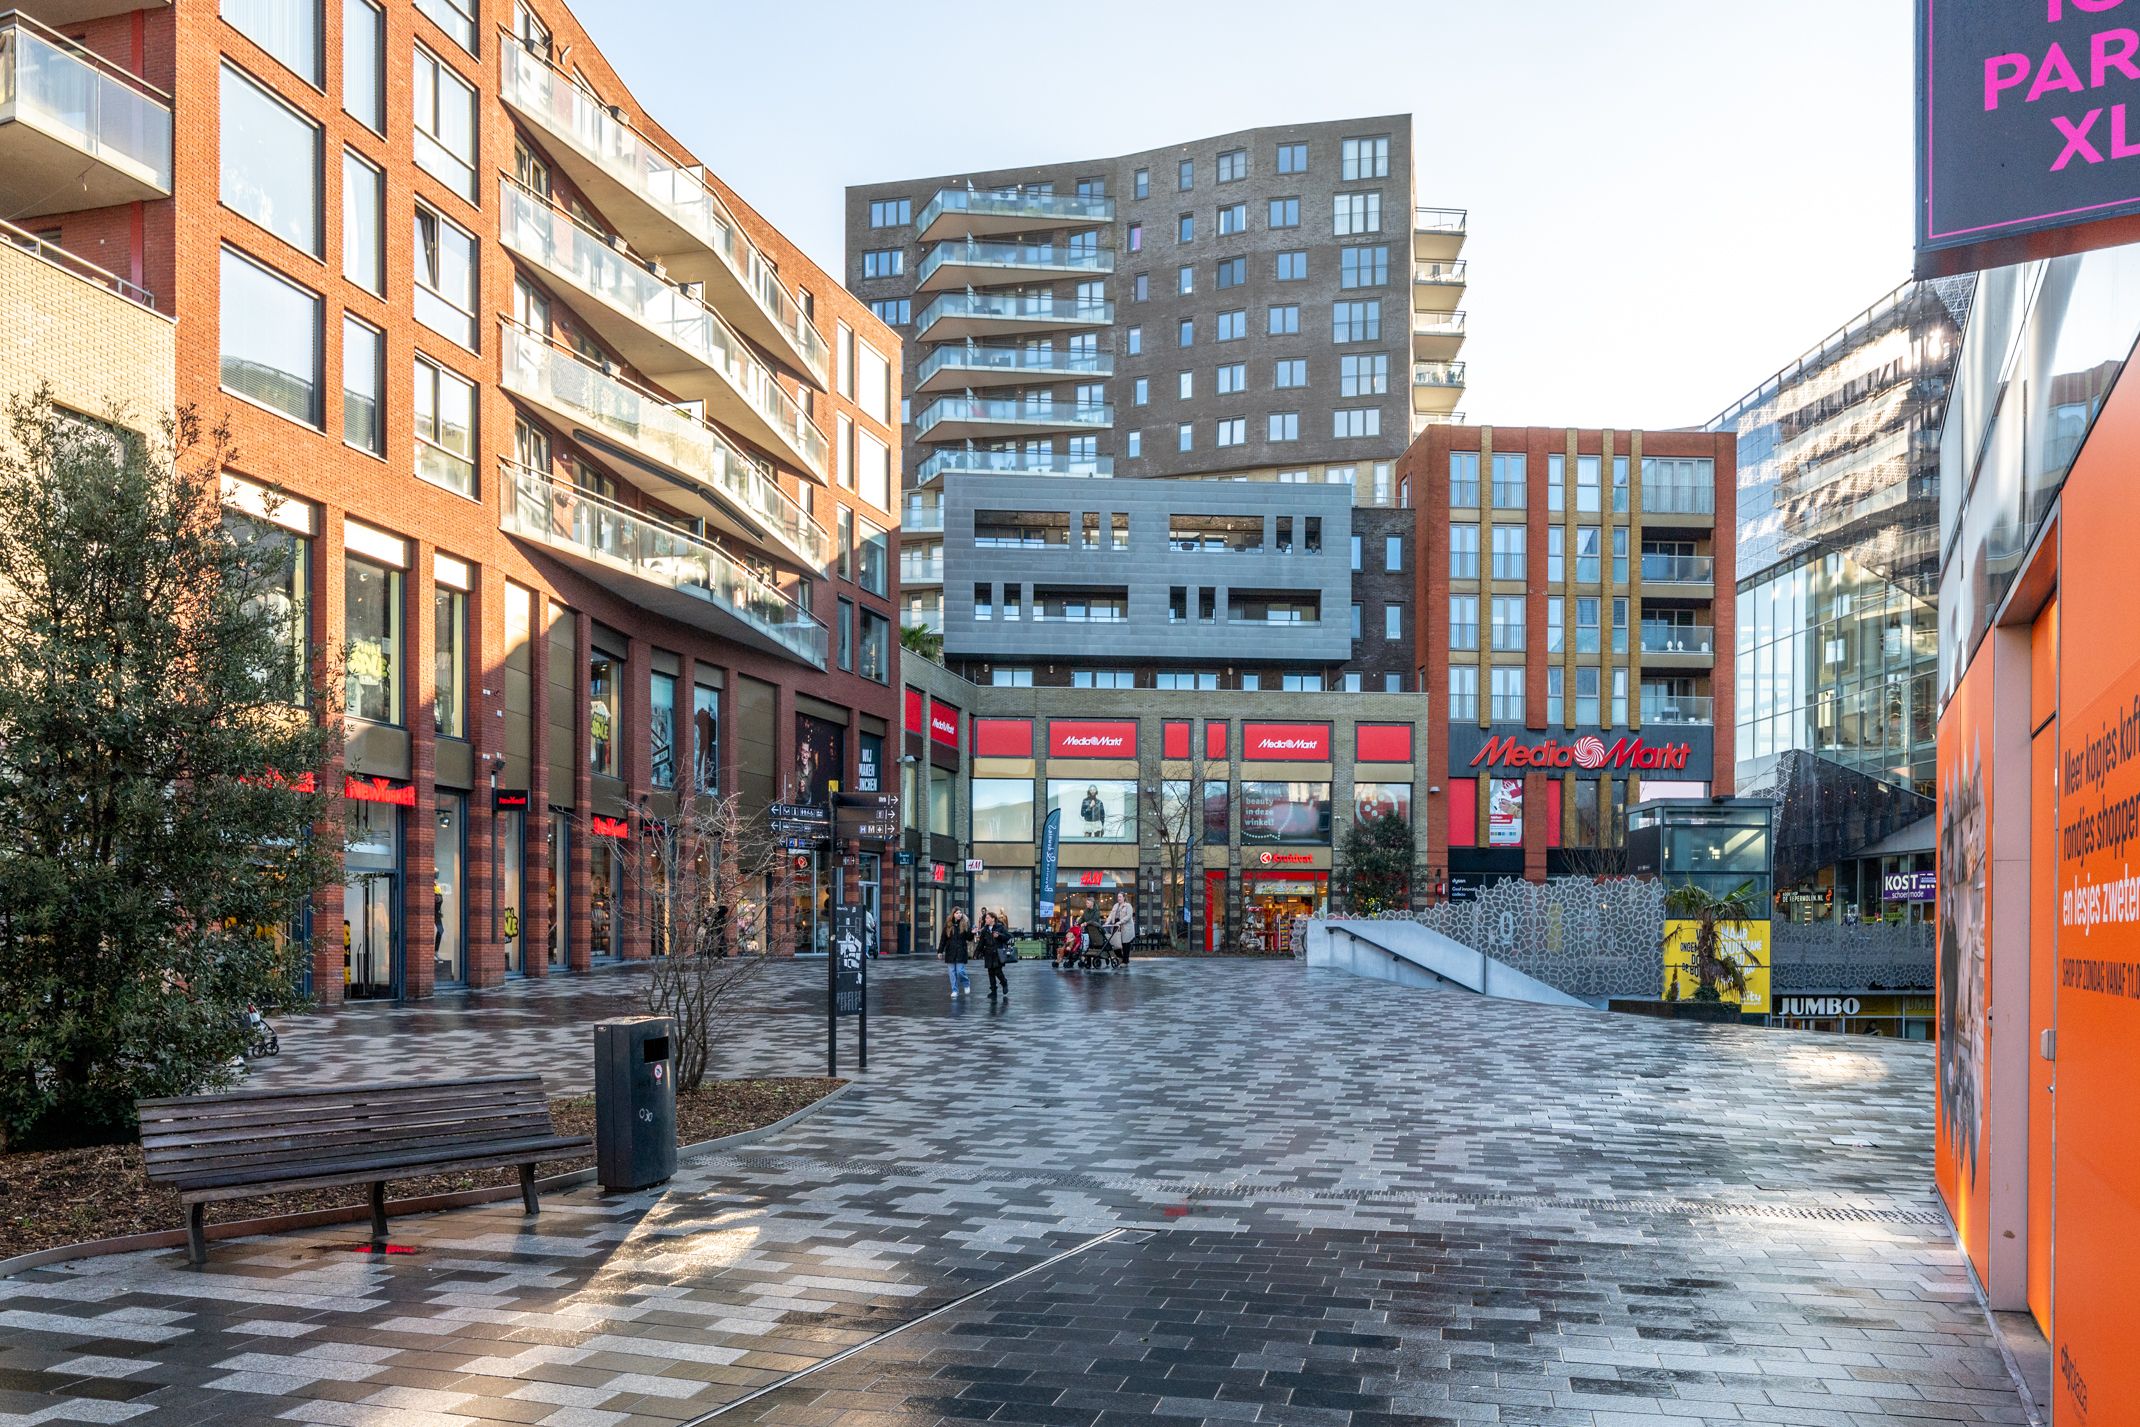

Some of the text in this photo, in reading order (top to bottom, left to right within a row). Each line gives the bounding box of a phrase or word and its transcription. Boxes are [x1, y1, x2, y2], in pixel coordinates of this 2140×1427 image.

[2064, 749, 2084, 797] Meer
[2086, 721, 2117, 793] kopjes
[1246, 797, 1274, 807] beauty
[1244, 818, 1274, 826] winkel!
[2064, 806, 2094, 867] rondjes
[2063, 890, 2073, 927] en
[2074, 872, 2101, 937] lesjes
[2063, 958, 2075, 988] SHOP
[2076, 959, 2083, 989] OP
[2083, 959, 2105, 993] ZONDAG
[2106, 961, 2126, 996] VANAF
[1779, 997, 1860, 1016] JUMBO
